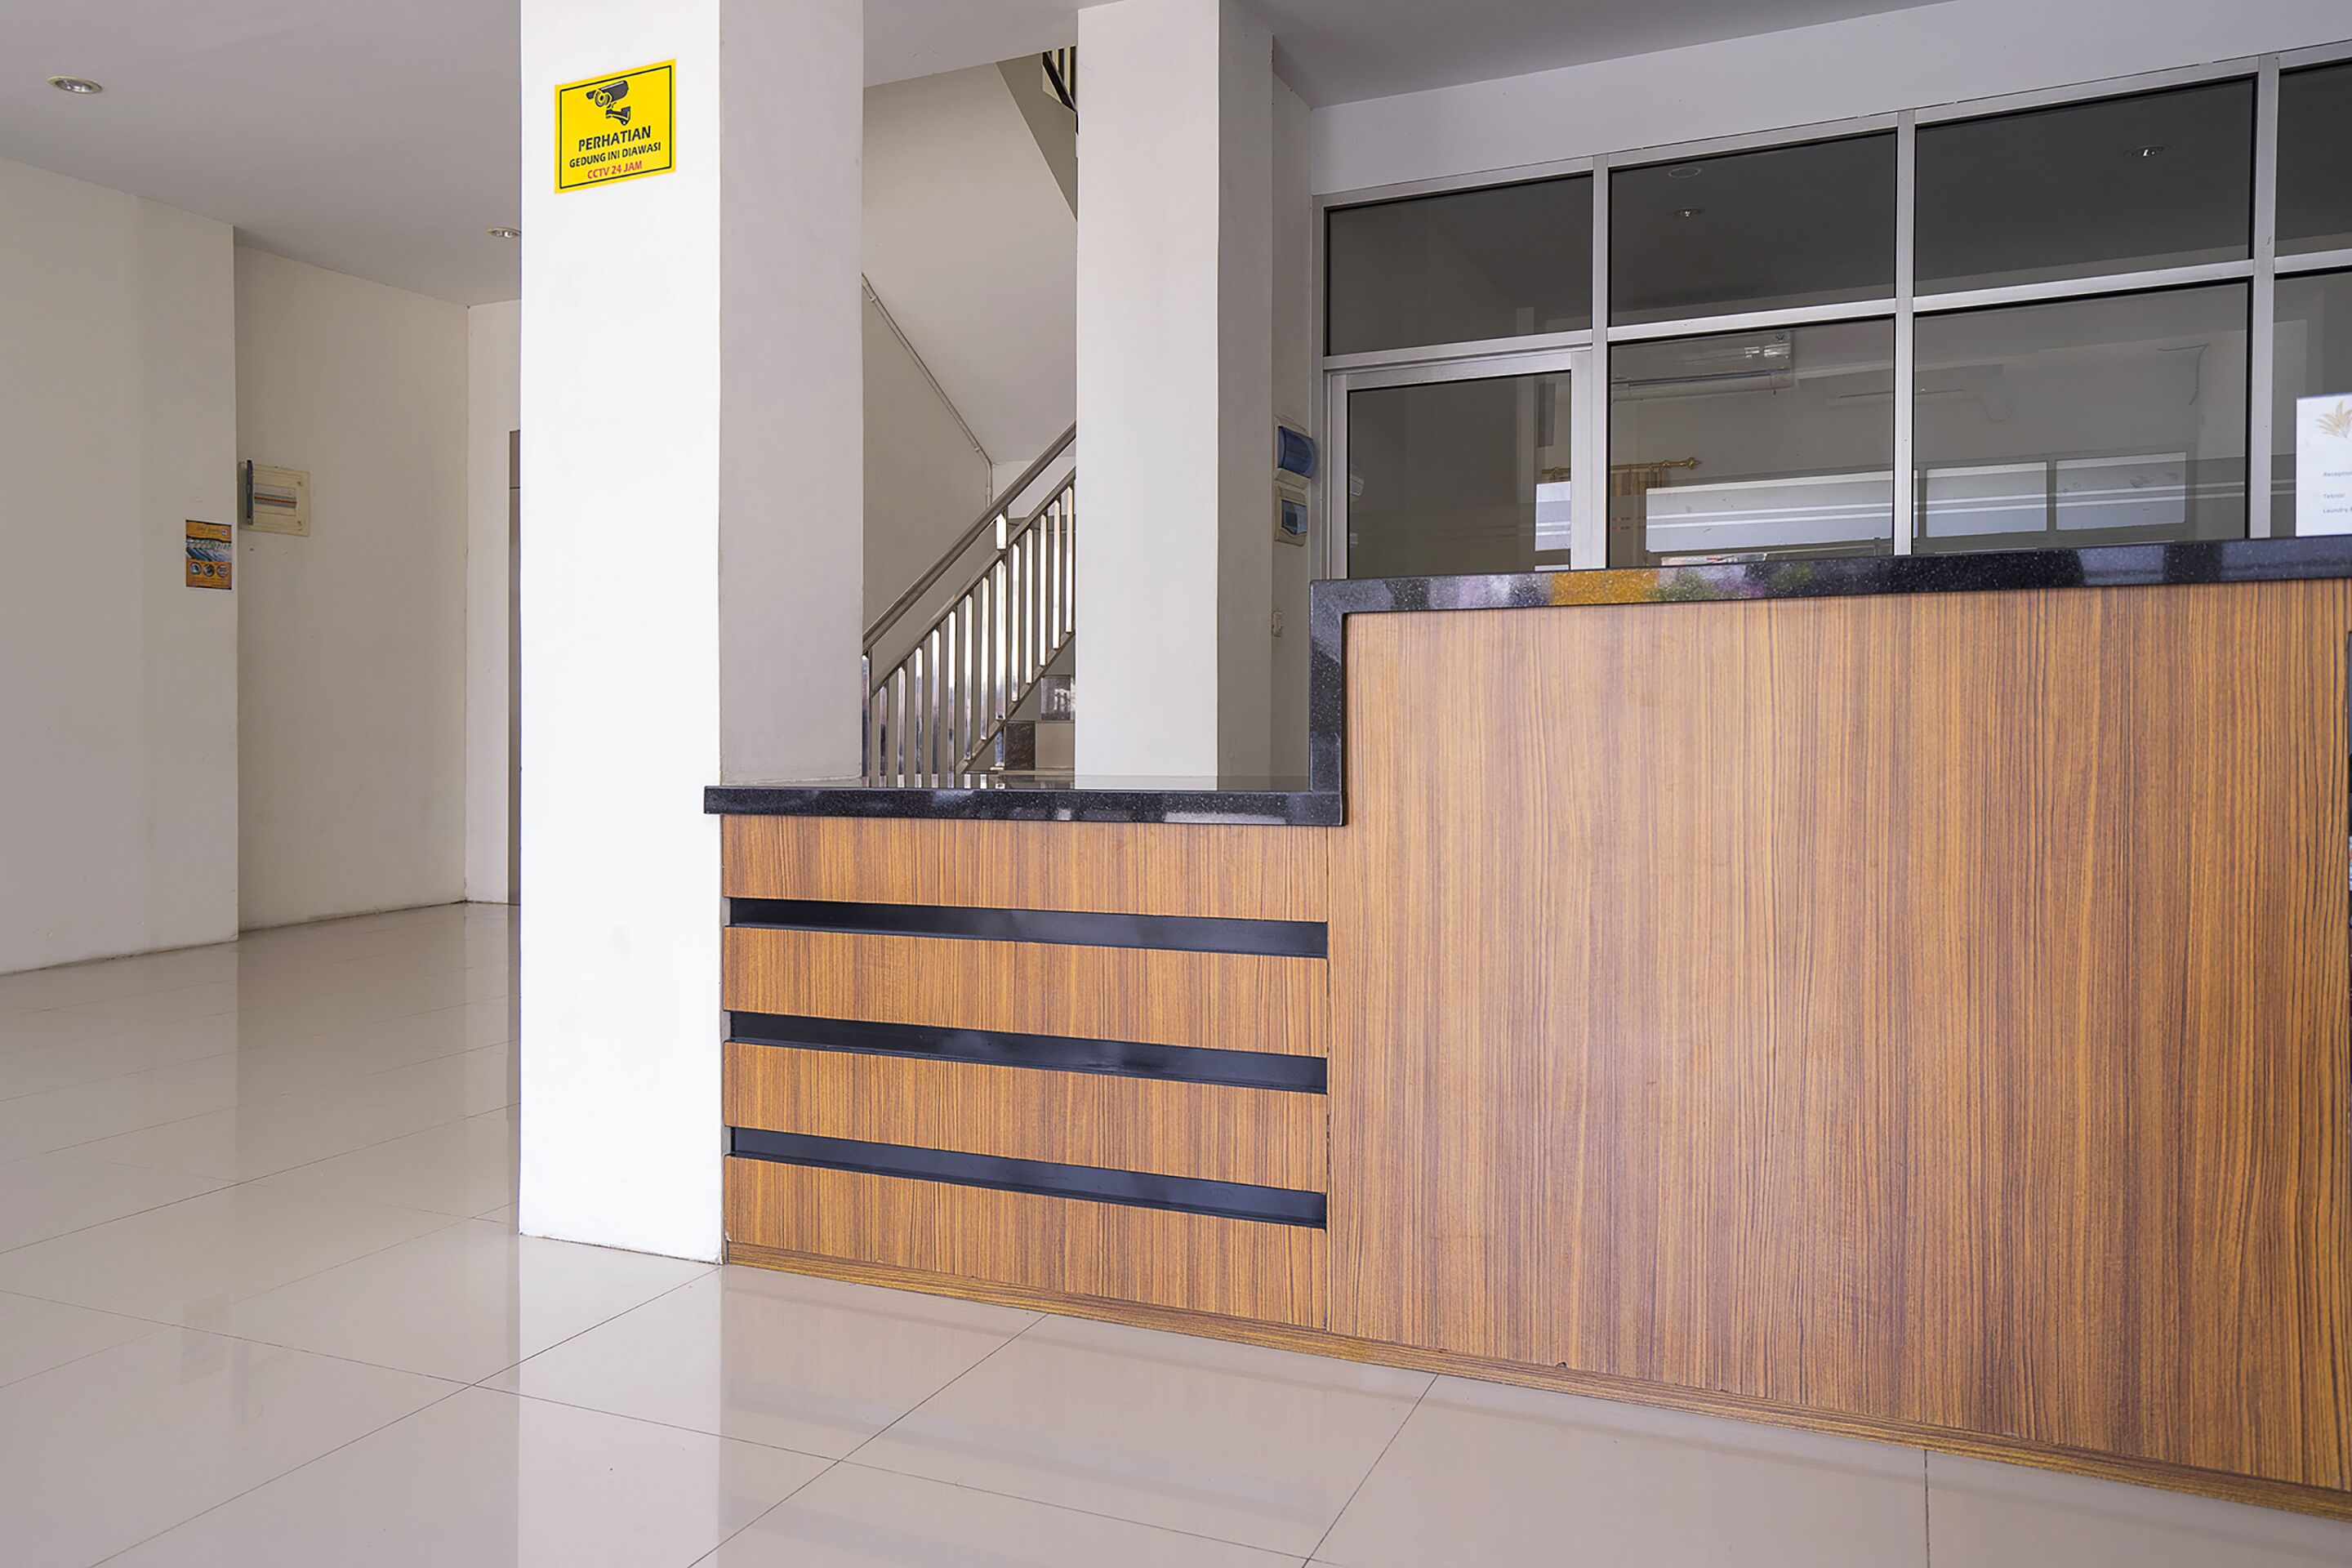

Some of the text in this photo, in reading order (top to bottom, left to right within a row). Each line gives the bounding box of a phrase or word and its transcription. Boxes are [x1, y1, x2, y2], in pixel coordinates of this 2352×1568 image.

[578, 126, 651, 152] PERHATIAN
[569, 141, 661, 168] GEDUNG INI DIAWASI
[587, 160, 643, 179] CCTV 24 JAM
